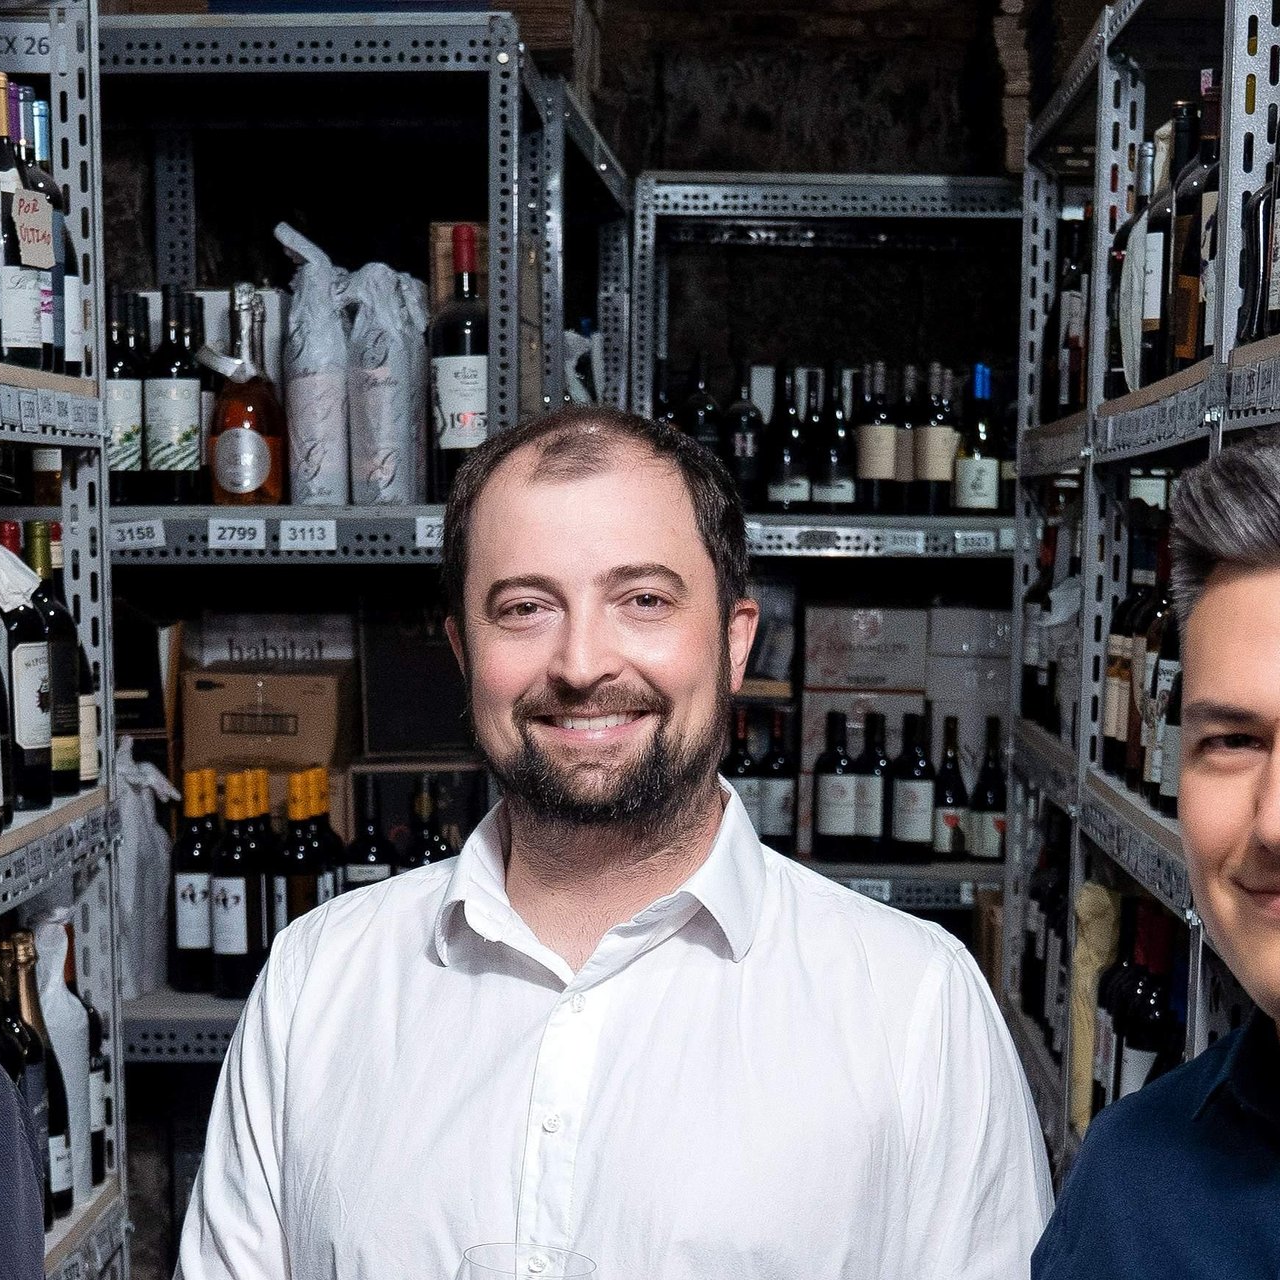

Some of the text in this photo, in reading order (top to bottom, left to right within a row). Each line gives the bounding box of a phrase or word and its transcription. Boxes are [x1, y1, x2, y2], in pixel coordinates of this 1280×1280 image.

[24, 35, 50, 56] 26
[18, 198, 40, 215] POR
[116, 527, 155, 542] 3158
[216, 526, 257, 541] 2799
[287, 526, 327, 541] 3113
